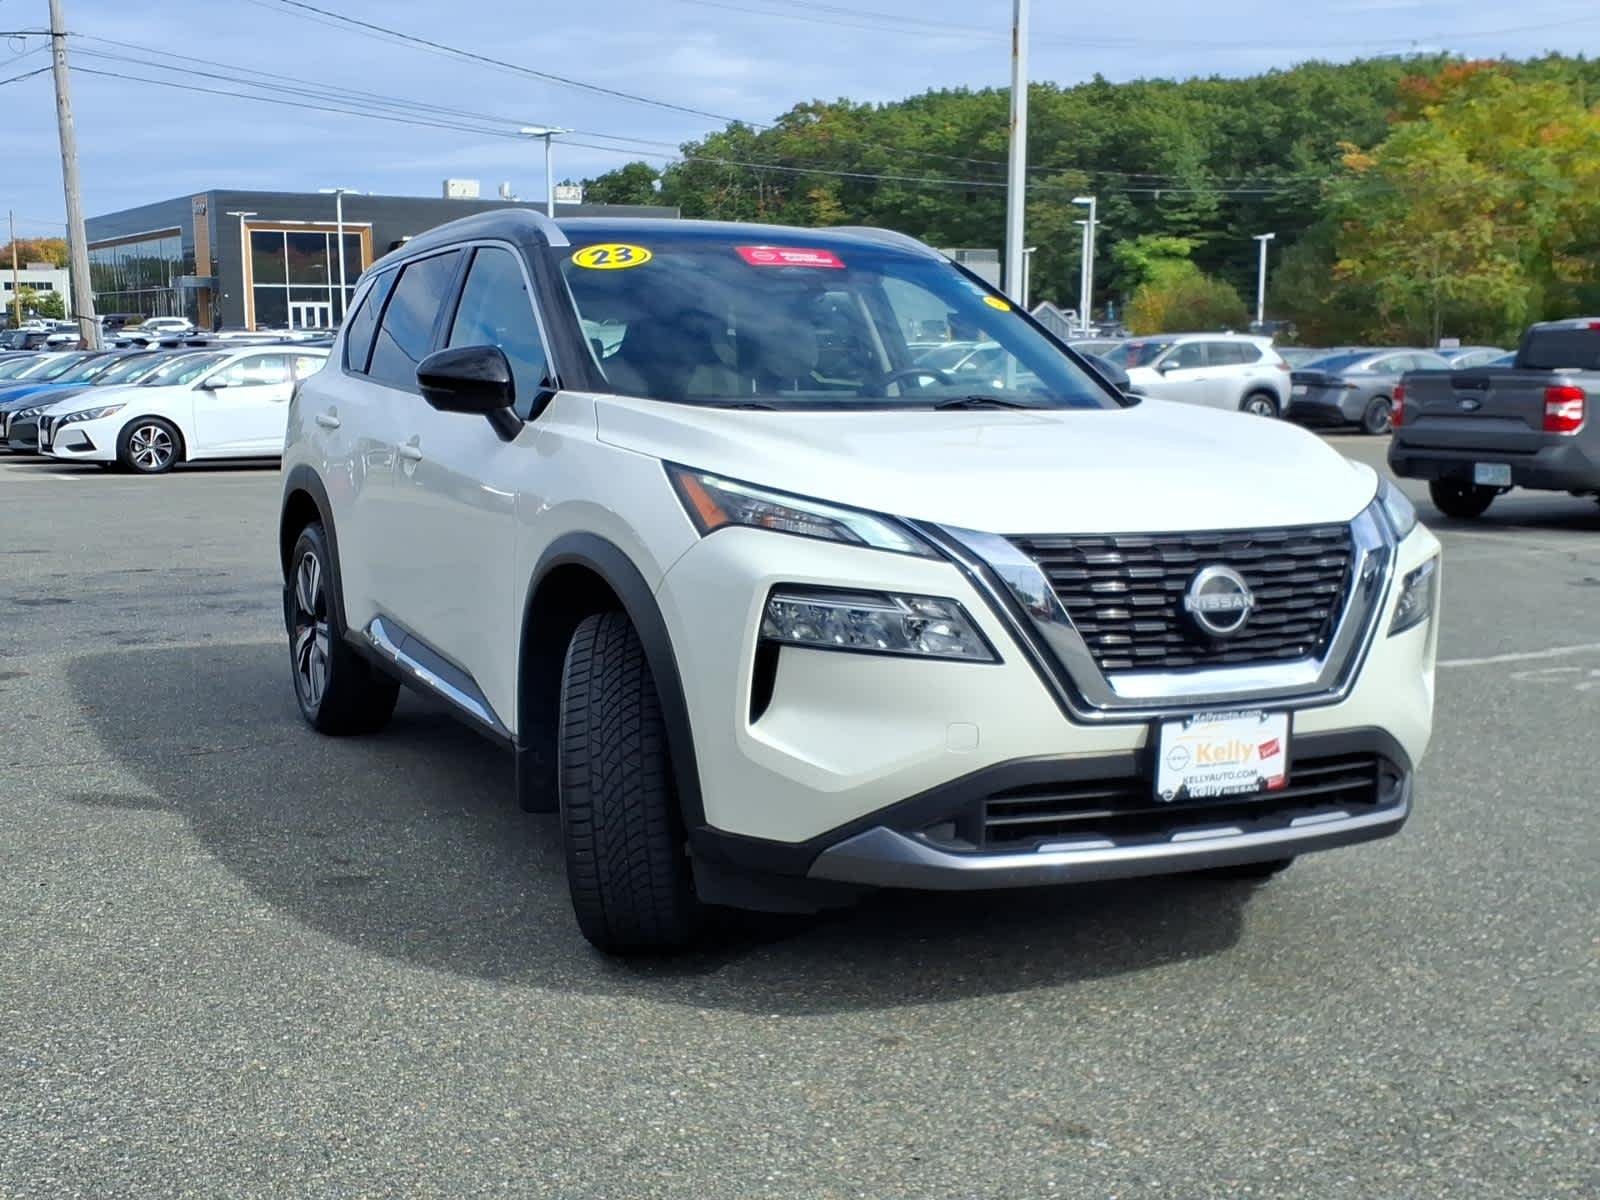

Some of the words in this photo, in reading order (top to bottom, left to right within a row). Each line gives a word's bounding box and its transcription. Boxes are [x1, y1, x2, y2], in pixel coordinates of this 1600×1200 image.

[590, 247, 633, 265] 23
[1185, 595, 1254, 609] NISSAN
[1196, 740, 1254, 763] Kelly
[1183, 769, 1258, 785] KELLYAUTO.COM
